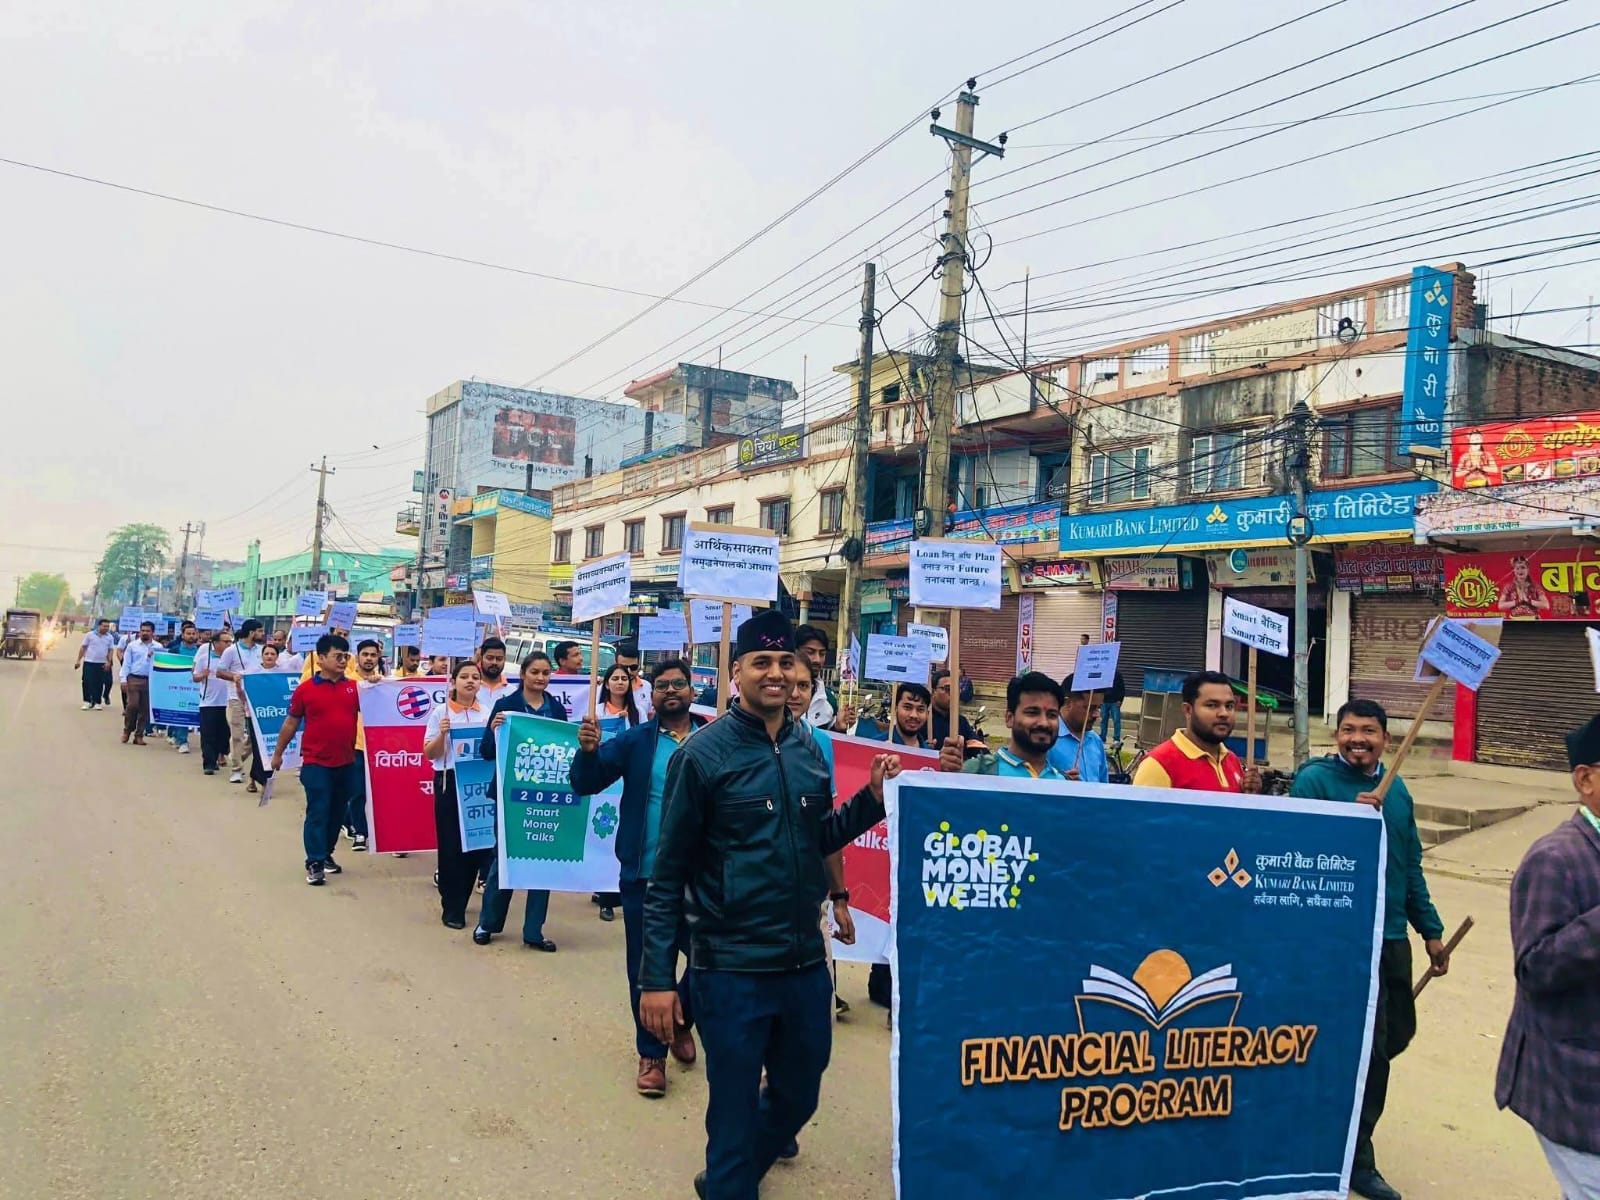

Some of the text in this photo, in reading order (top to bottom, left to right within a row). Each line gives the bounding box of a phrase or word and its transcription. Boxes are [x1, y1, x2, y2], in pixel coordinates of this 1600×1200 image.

[509, 461, 548, 473] Creive
[1334, 491, 1412, 519] लिमिटेड
[1070, 522, 1112, 540] KUMARI
[1114, 518, 1146, 537] BANK
[1149, 515, 1199, 534] LIMITED
[916, 549, 940, 559] Loan
[975, 552, 996, 561] Plan
[958, 564, 991, 574] Future
[1231, 608, 1257, 624] Smart
[1231, 626, 1256, 642] Smart
[516, 742, 577, 759] GLOBA
[515, 756, 573, 772] MONE
[526, 806, 560, 817] Smart
[522, 818, 560, 831] Money
[525, 831, 555, 842] Talks
[853, 830, 889, 851] alks
[923, 831, 1039, 860] GLOBAL
[922, 857, 1028, 884] MONEY
[1255, 852, 1293, 871] कुमारी
[1316, 854, 1357, 871] लिमिटेड
[1255, 874, 1355, 893] KUMARI BANK LIMITED
[921, 882, 1009, 909] WEEK
[960, 1025, 1318, 1086] FINANCIAL LITERACY
[1058, 1074, 1233, 1131] PROGRAM
